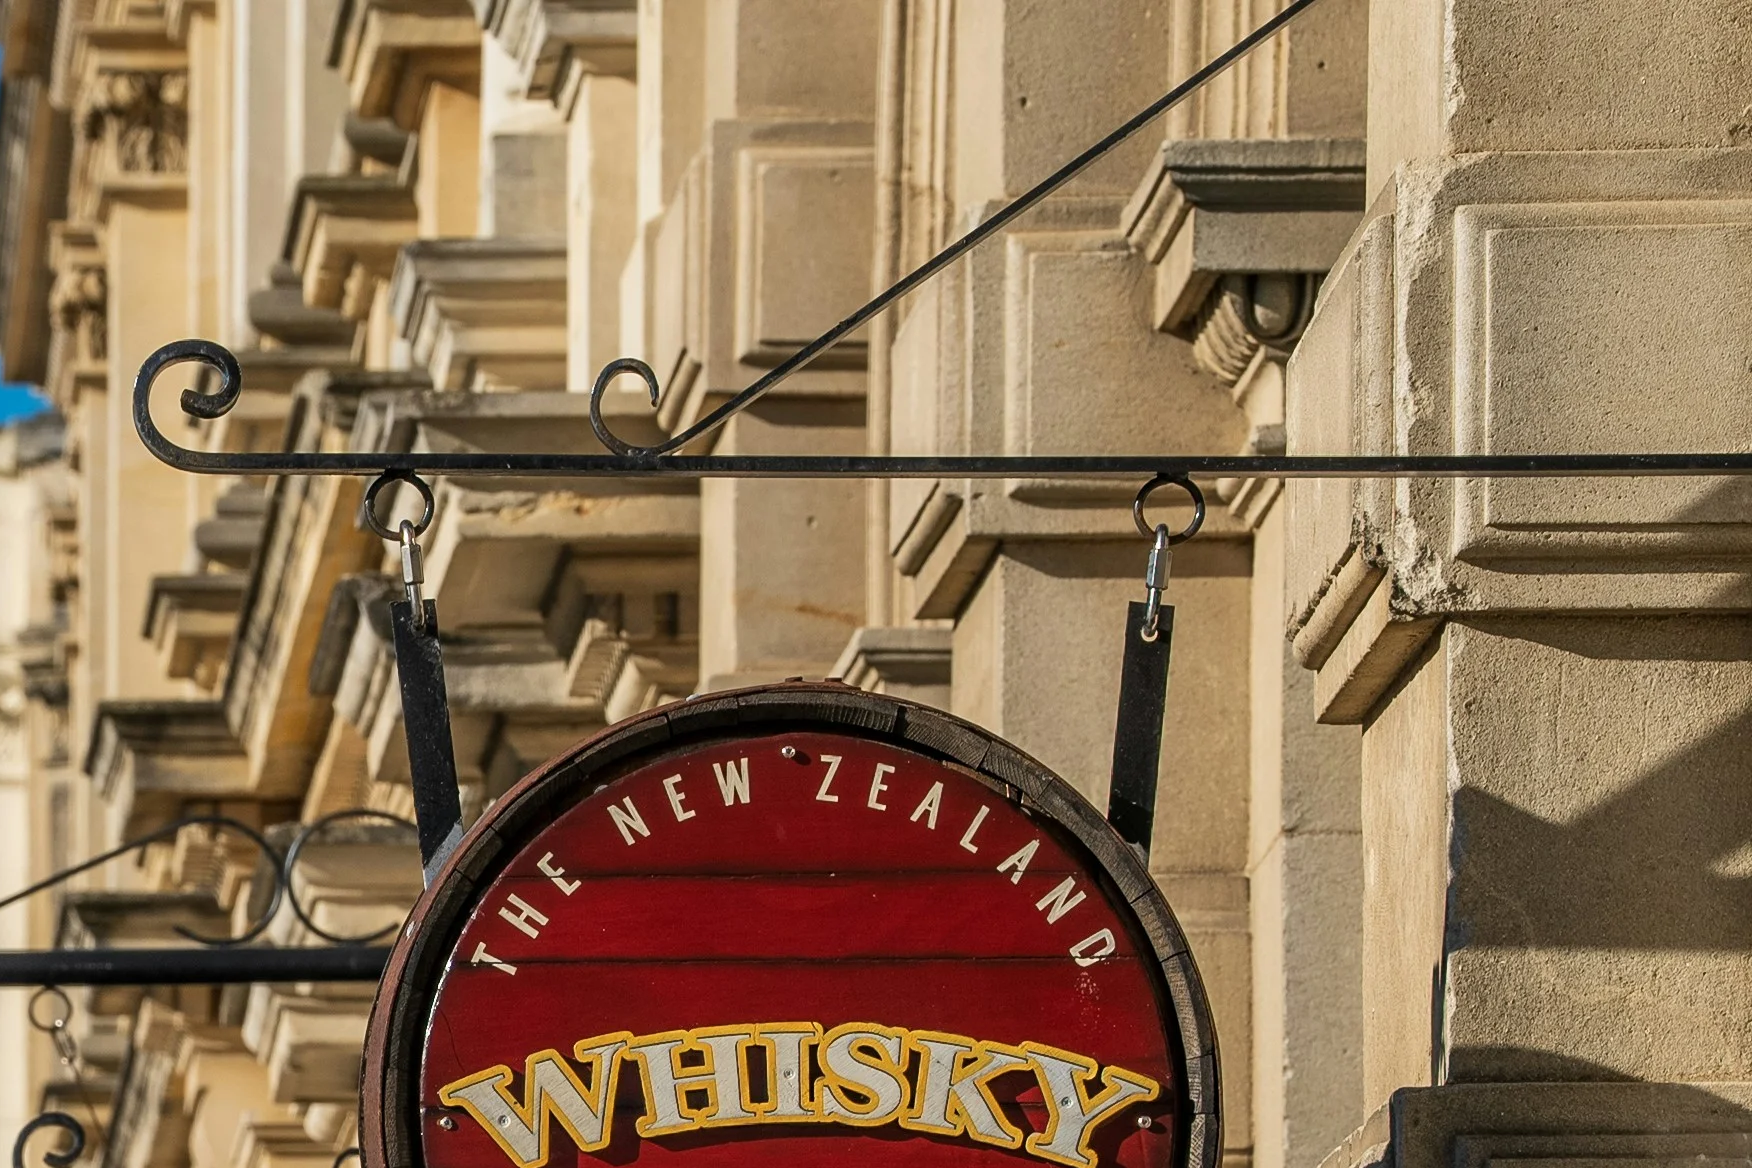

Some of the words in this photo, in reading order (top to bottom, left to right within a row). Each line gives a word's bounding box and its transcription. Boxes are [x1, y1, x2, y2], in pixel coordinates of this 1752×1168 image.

[471, 851, 581, 975] THE
[607, 758, 751, 846] NEW
[815, 755, 1116, 968] ZEALAND
